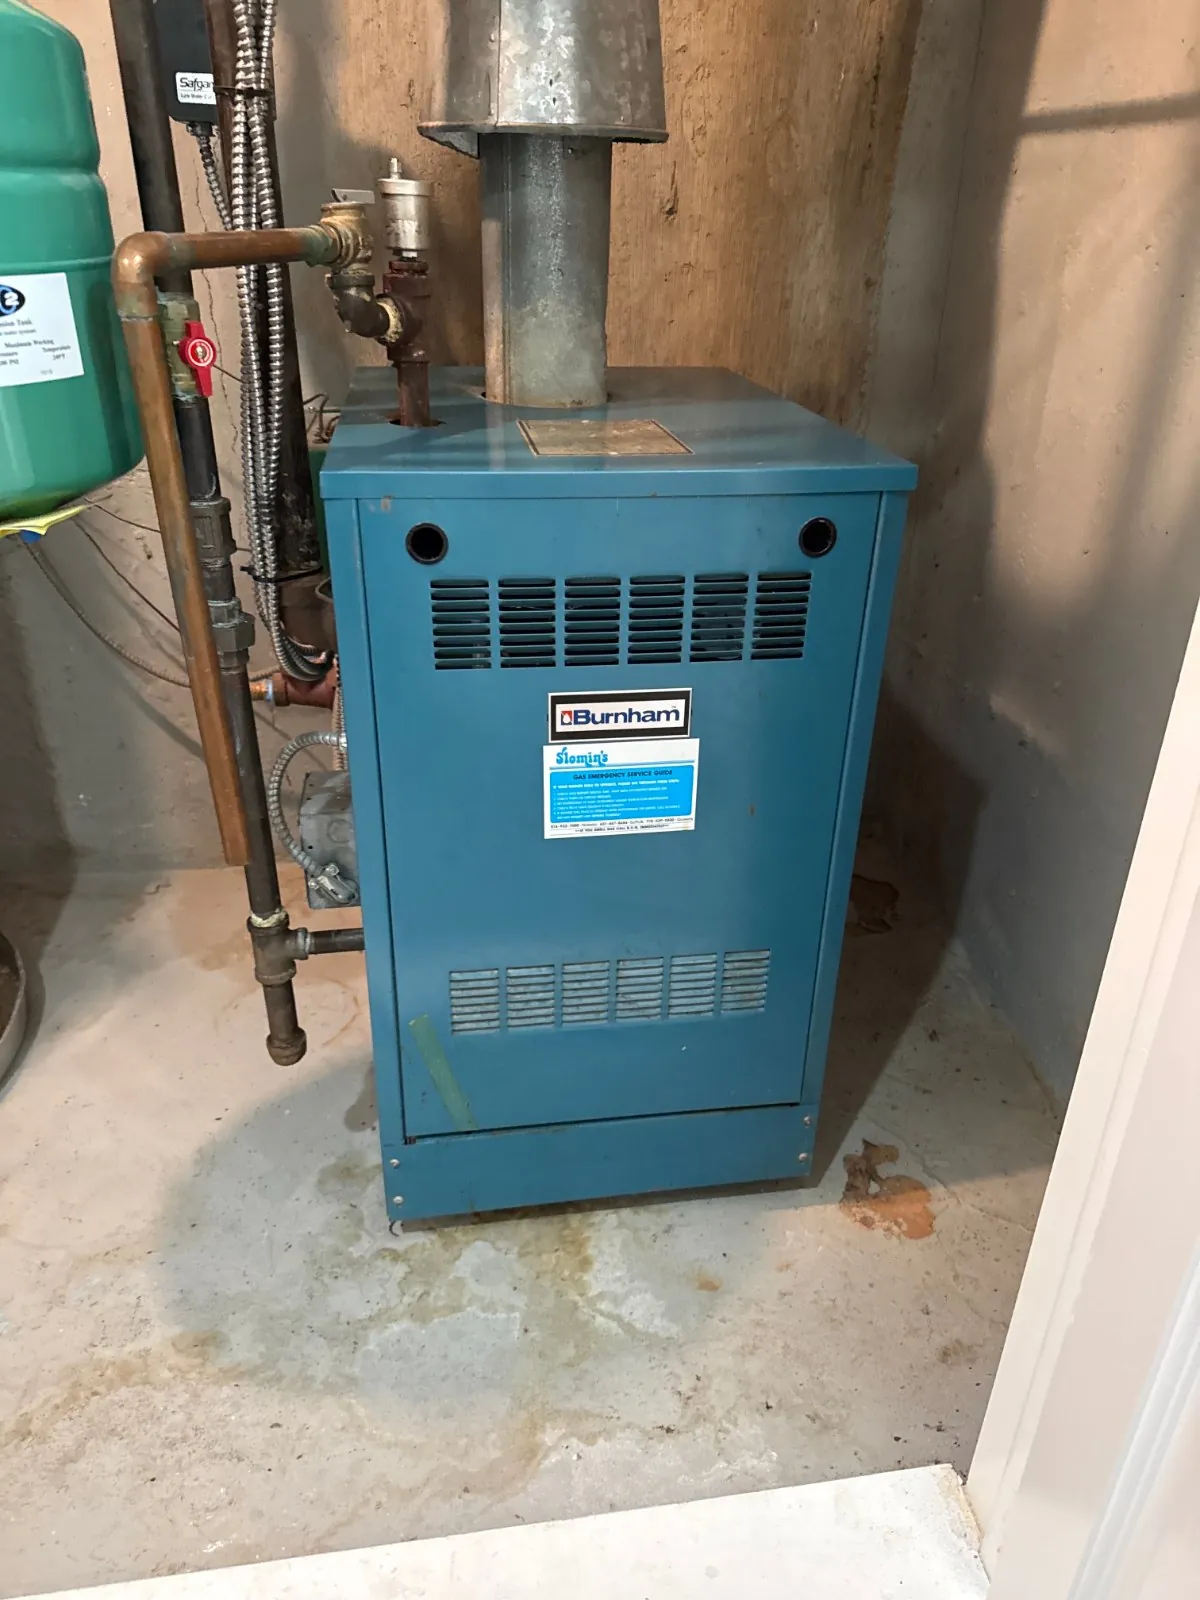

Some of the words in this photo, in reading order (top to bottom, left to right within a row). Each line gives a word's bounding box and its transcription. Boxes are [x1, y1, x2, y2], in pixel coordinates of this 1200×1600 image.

[180, 77, 214, 91] Safgar
[574, 707, 680, 725] Burnham
[556, 747, 608, 767] Slomin's
[588, 772, 625, 780] EMERGENCY
